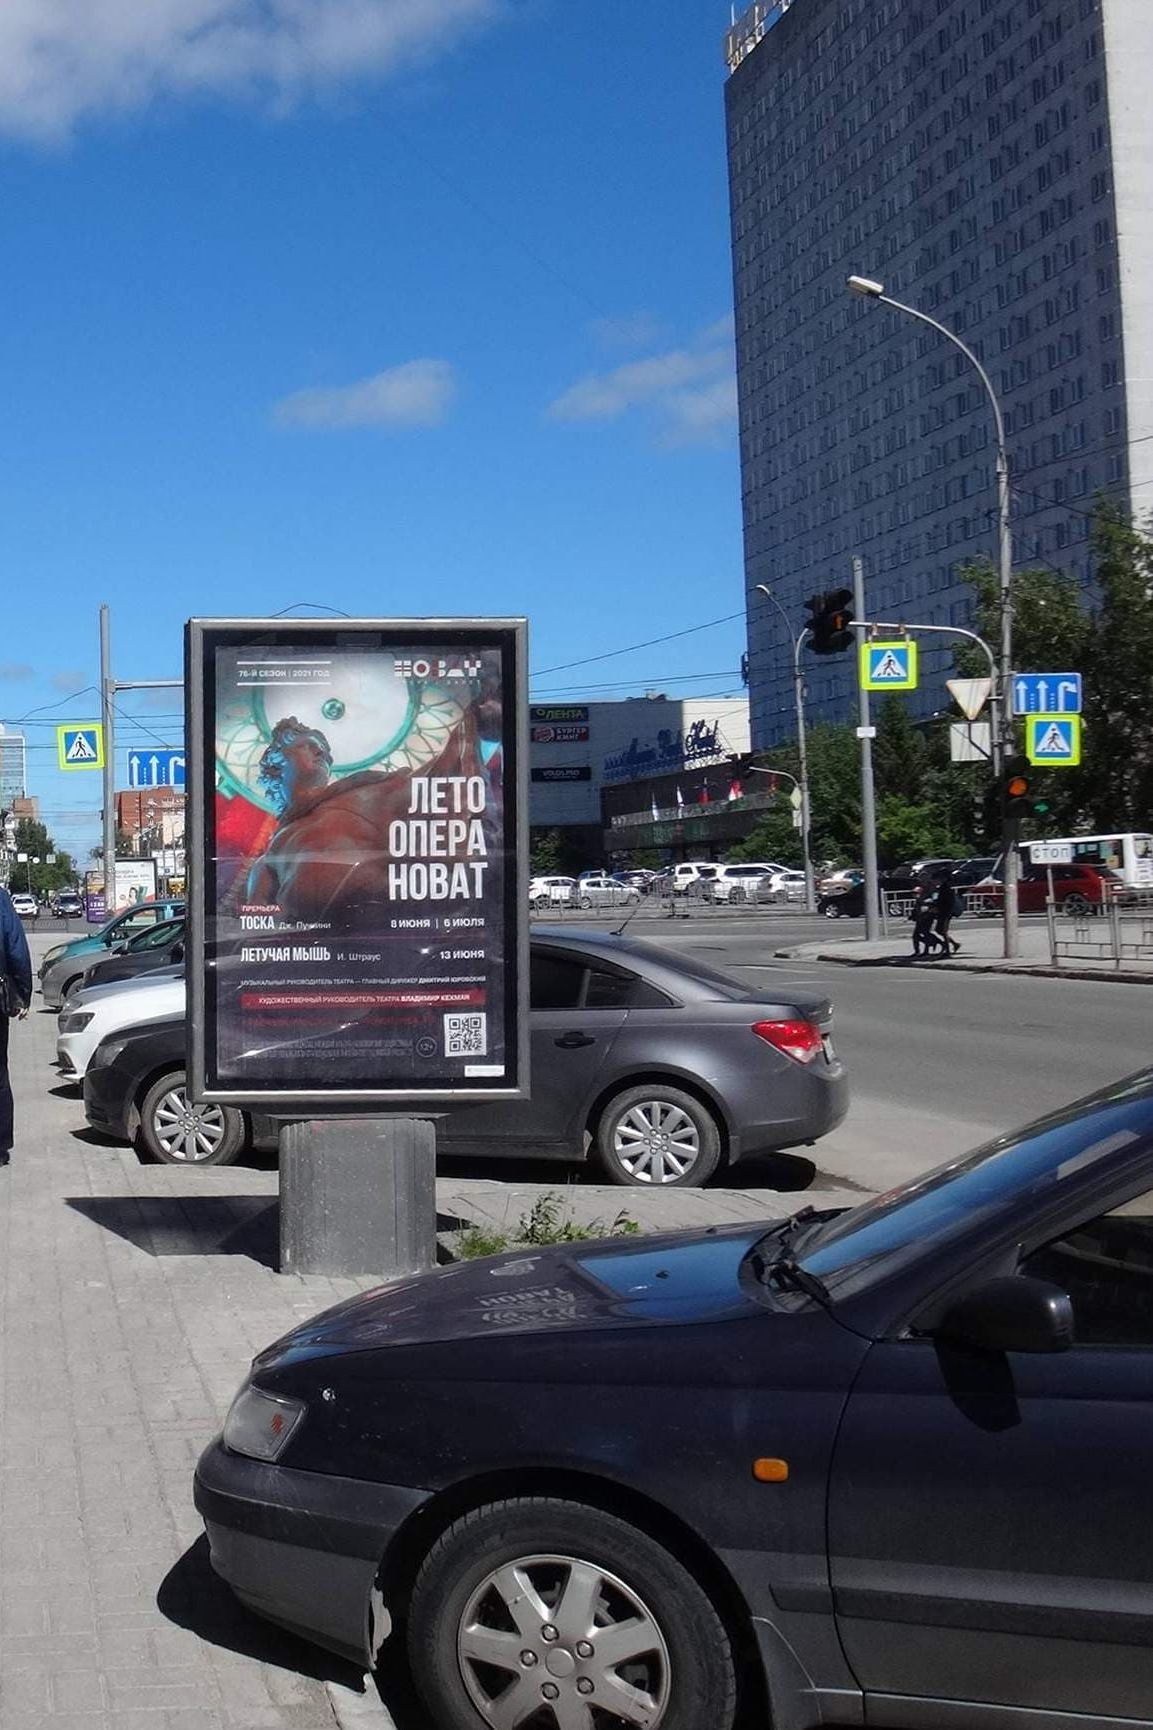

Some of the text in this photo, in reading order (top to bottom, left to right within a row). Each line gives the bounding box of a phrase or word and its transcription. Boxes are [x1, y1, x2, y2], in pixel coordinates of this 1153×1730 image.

[258, 669, 287, 678] СЕЗОН
[292, 669, 311, 678] 2021
[312, 669, 331, 678] ГОД
[546, 710, 584, 719] ЛЕНТА
[408, 776, 486, 814] ЛЕТО
[388, 819, 487, 858] ОПЕРА
[1032, 848, 1069, 859] СТОП
[388, 862, 489, 901] НОВАТ
[242, 904, 281, 912] ПРЕМЬЕРА
[240, 915, 275, 930] ТОСКА
[390, 918, 485, 929] 8 ИЮНЯ 6 ИЮЛЯ
[240, 947, 291, 962] ЛЕТУЧАЯ
[292, 947, 331, 961] МЫШЬ
[348, 953, 381, 963] Штраус
[439, 949, 485, 960] 13 ИЮНЯ
[323, 994, 376, 1004] РУКОВОДИТЕЛЬ
[376, 994, 400, 1003] ТЕАТРА
[400, 994, 440, 1003] ВЛАДИМИР
